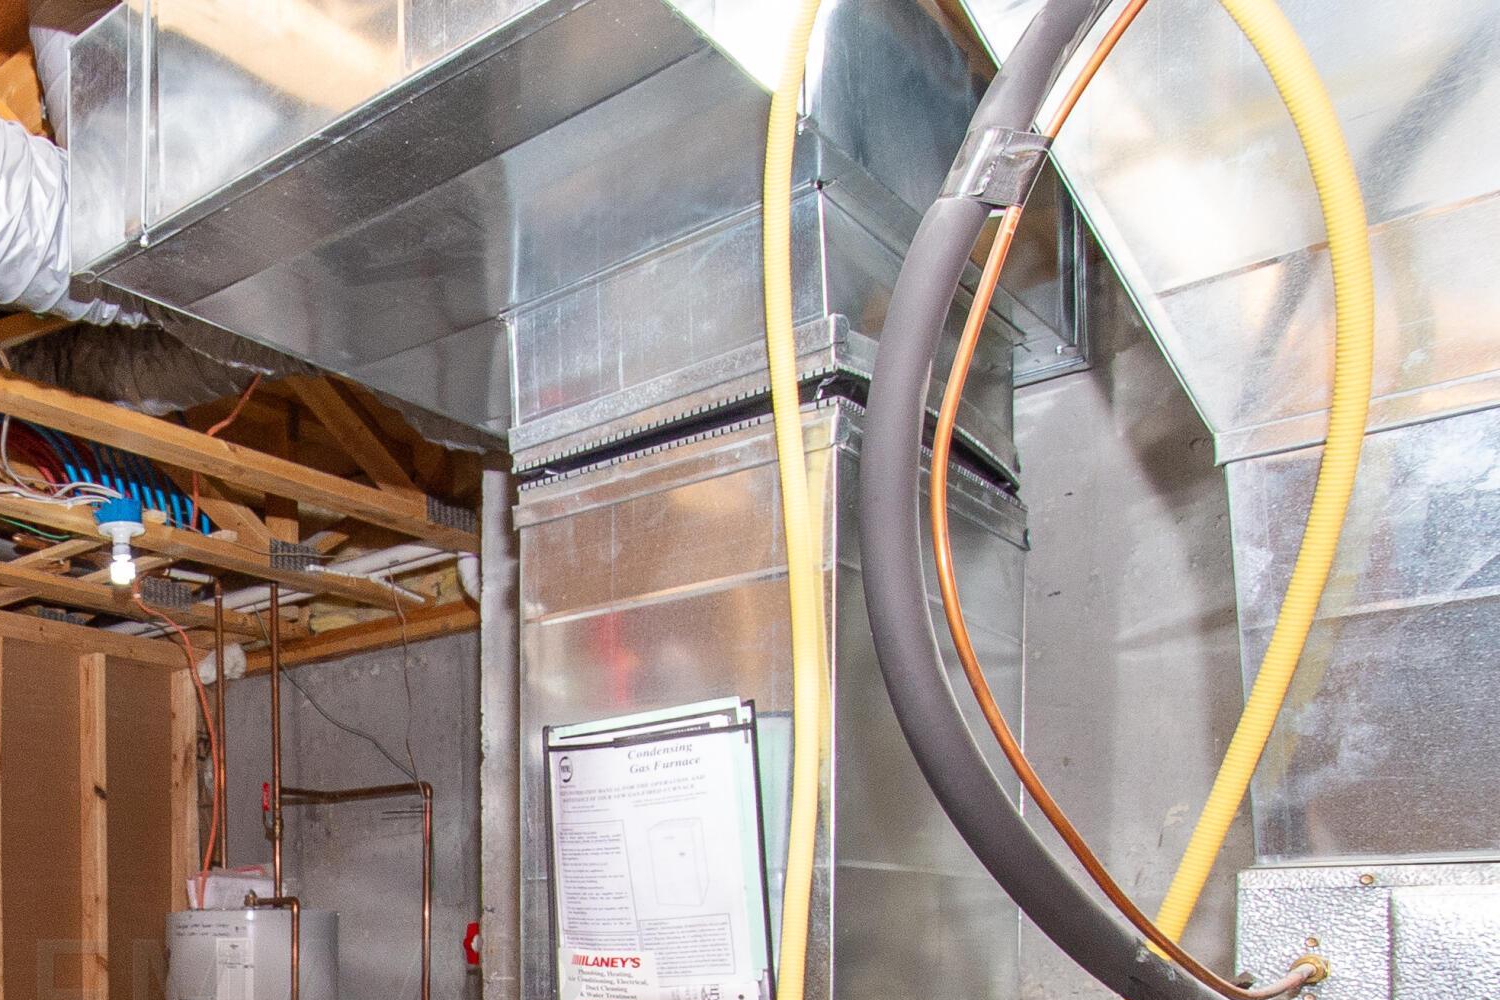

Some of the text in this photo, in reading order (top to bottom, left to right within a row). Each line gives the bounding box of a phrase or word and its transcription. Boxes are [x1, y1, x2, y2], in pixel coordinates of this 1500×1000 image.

[627, 743, 693, 761] Condensing
[629, 756, 701, 775] Gas Furnace
[583, 956, 641, 968] LANEY'S
[578, 969, 634, 978] Plumbing, Heating,
[582, 976, 615, 986] Conditioning,
